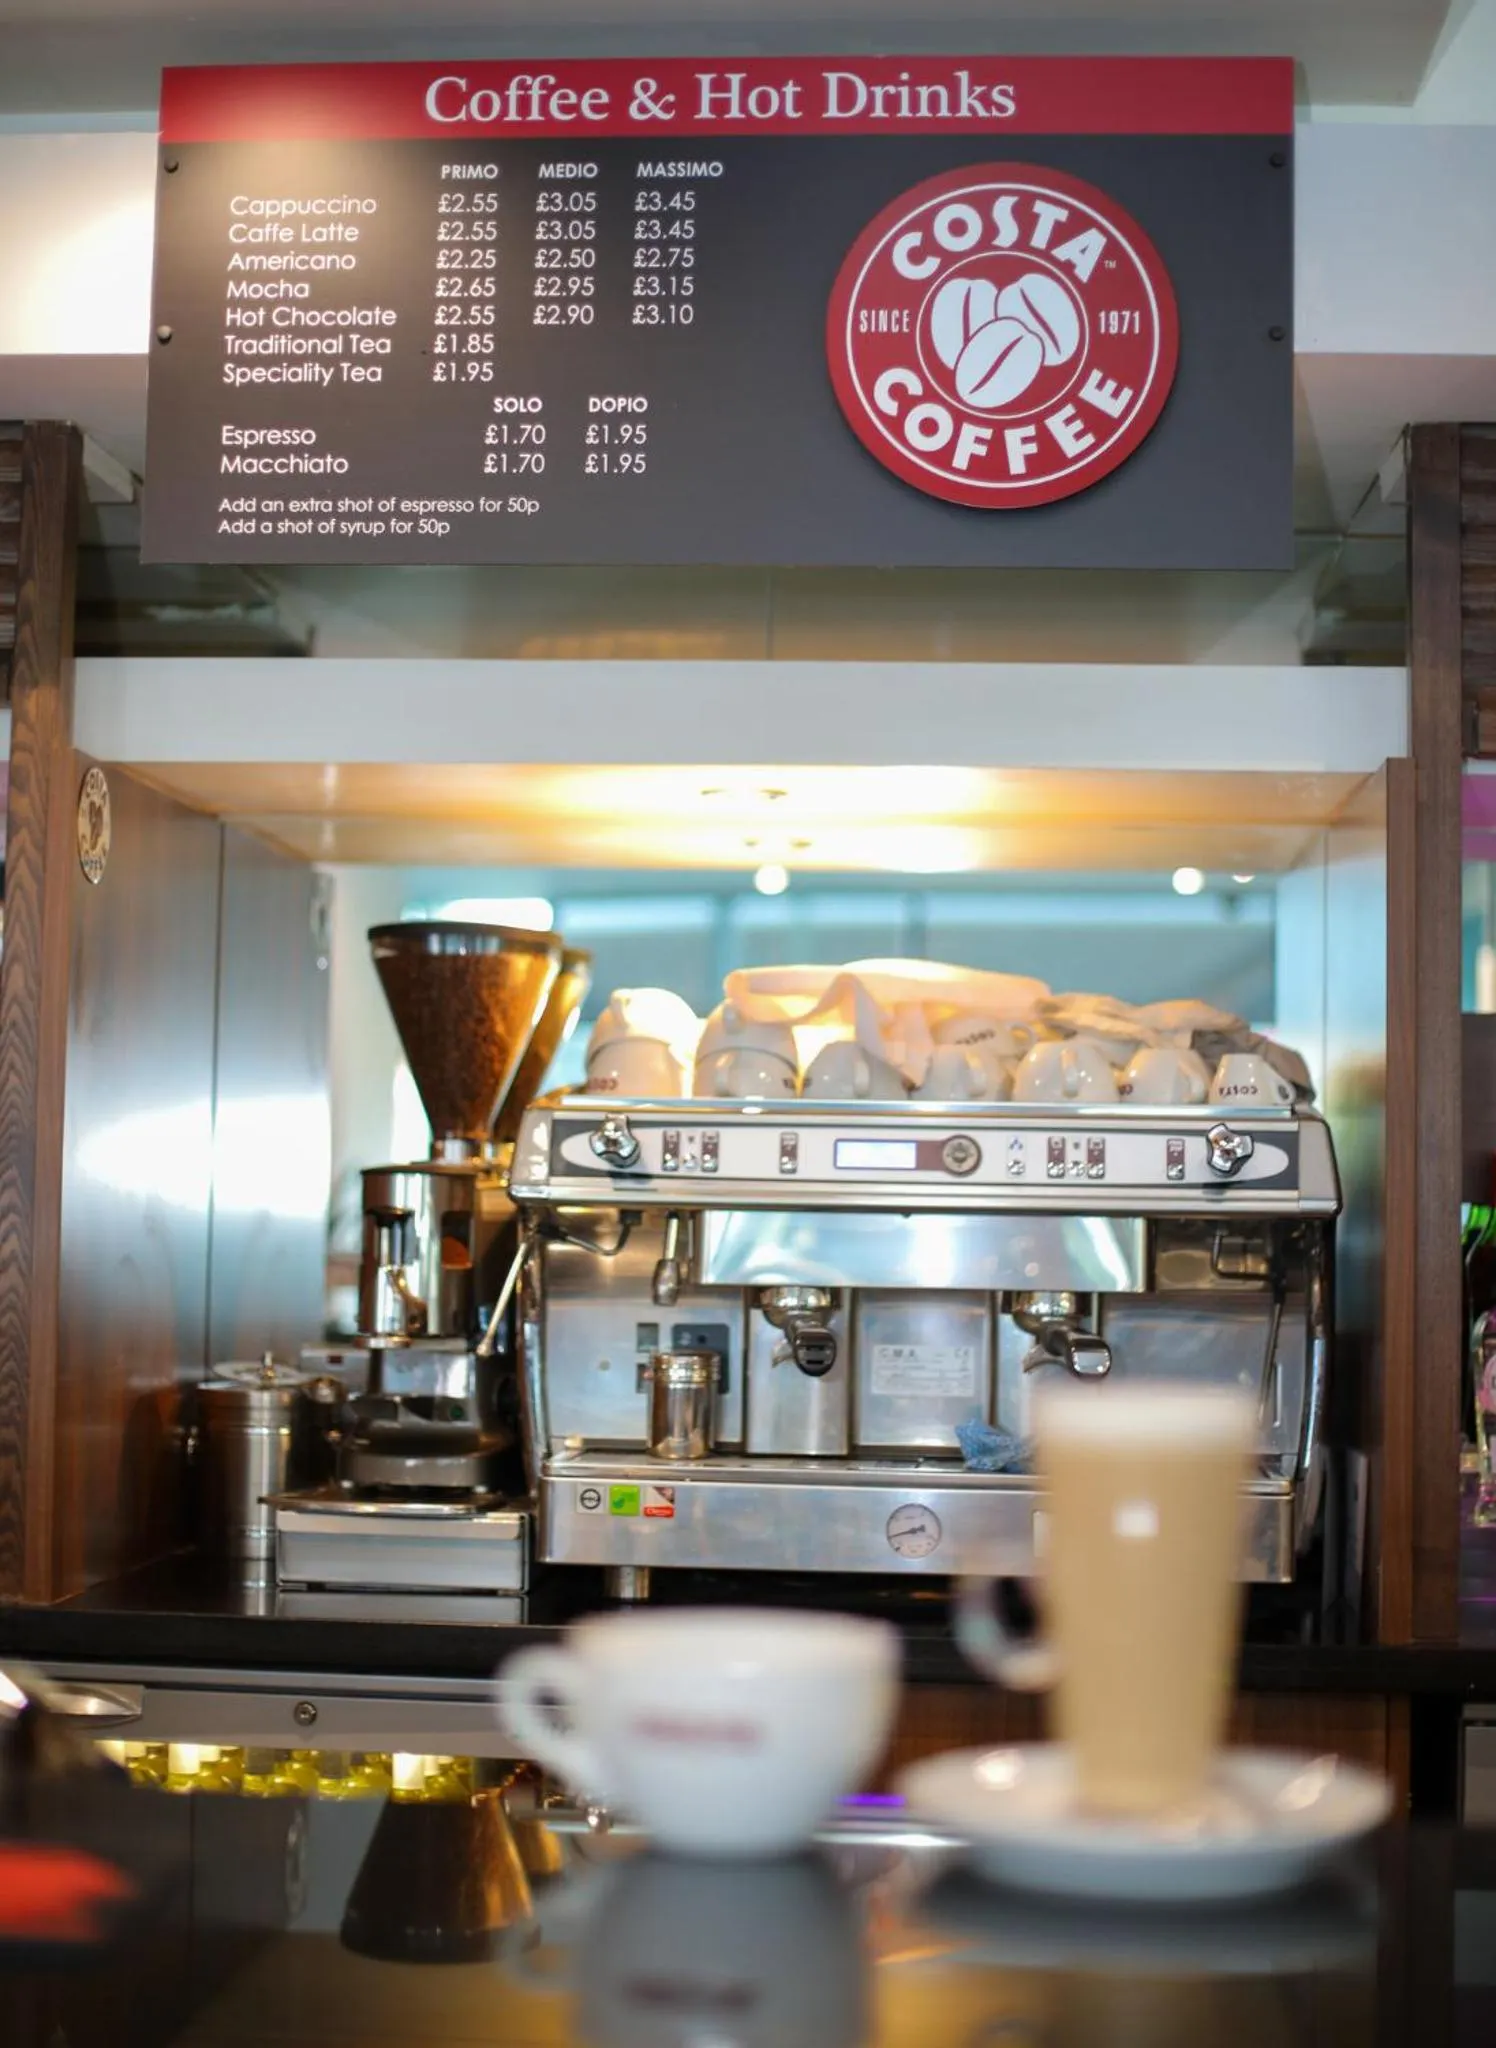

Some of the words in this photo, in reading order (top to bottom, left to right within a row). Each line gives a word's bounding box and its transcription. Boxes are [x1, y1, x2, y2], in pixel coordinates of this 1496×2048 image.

[424, 74, 610, 123] Coffee
[628, 77, 676, 121] &
[693, 72, 803, 120] Hot
[821, 69, 1017, 119] Drinks
[440, 163, 500, 180] PRIMO
[537, 162, 599, 179] MEDIO
[635, 160, 724, 178] MASSIMO
[229, 194, 378, 219] Cappuccino
[437, 192, 499, 214] £2.55
[535, 191, 597, 213] £3.05
[634, 190, 696, 212] £3.45
[228, 223, 295, 244] Caffe
[301, 222, 360, 243] Latte
[436, 220, 498, 242] £2.55
[534, 219, 596, 241] £3.05
[633, 219, 695, 240] £3.45
[891, 195, 1108, 283] COSTA
[226, 250, 357, 272] Americano
[435, 248, 497, 270] £2.25
[533, 247, 596, 269] £2.50
[632, 247, 695, 268] £2.75
[226, 279, 311, 300] Mocha
[434, 276, 497, 298] £2.65
[533, 275, 595, 298] £2.95
[632, 275, 695, 297] £3.15
[225, 307, 266, 327] Hot
[271, 305, 398, 327] Chocolate
[433, 304, 496, 326] £2.55
[532, 303, 595, 326] £2.90
[631, 303, 695, 325] £3.10
[859, 309, 910, 333] SINCE
[1098, 310, 1141, 335] 1971
[223, 333, 343, 355] Traditional
[348, 333, 392, 355] Tea
[433, 332, 495, 355] £1.85
[222, 362, 335, 388] Speciality
[339, 362, 383, 383] Tea
[432, 361, 494, 383] £1.95
[492, 396, 544, 414] SOLO
[588, 395, 649, 414] DOPIO
[873, 367, 1132, 476] COFFEE
[221, 424, 317, 449] Espresso
[483, 423, 547, 445] £1.70
[584, 423, 648, 445] £1.95
[219, 452, 350, 475] Macchiato
[483, 452, 546, 474] £1.70
[583, 452, 647, 474] £1.95
[217, 496, 257, 513] Add
[260, 499, 285, 513] an
[287, 497, 334, 513] extra
[336, 496, 374, 513] shot
[377, 495, 397, 513] of
[399, 499, 475, 517] espresso
[478, 495, 504, 513] for
[506, 496, 541, 517] 50p
[216, 518, 257, 535] Add
[259, 521, 273, 535] a
[276, 518, 314, 535] shot
[317, 517, 337, 534] of
[339, 521, 386, 539] syrup
[389, 517, 415, 535] for
[417, 518, 451, 539] 50p
